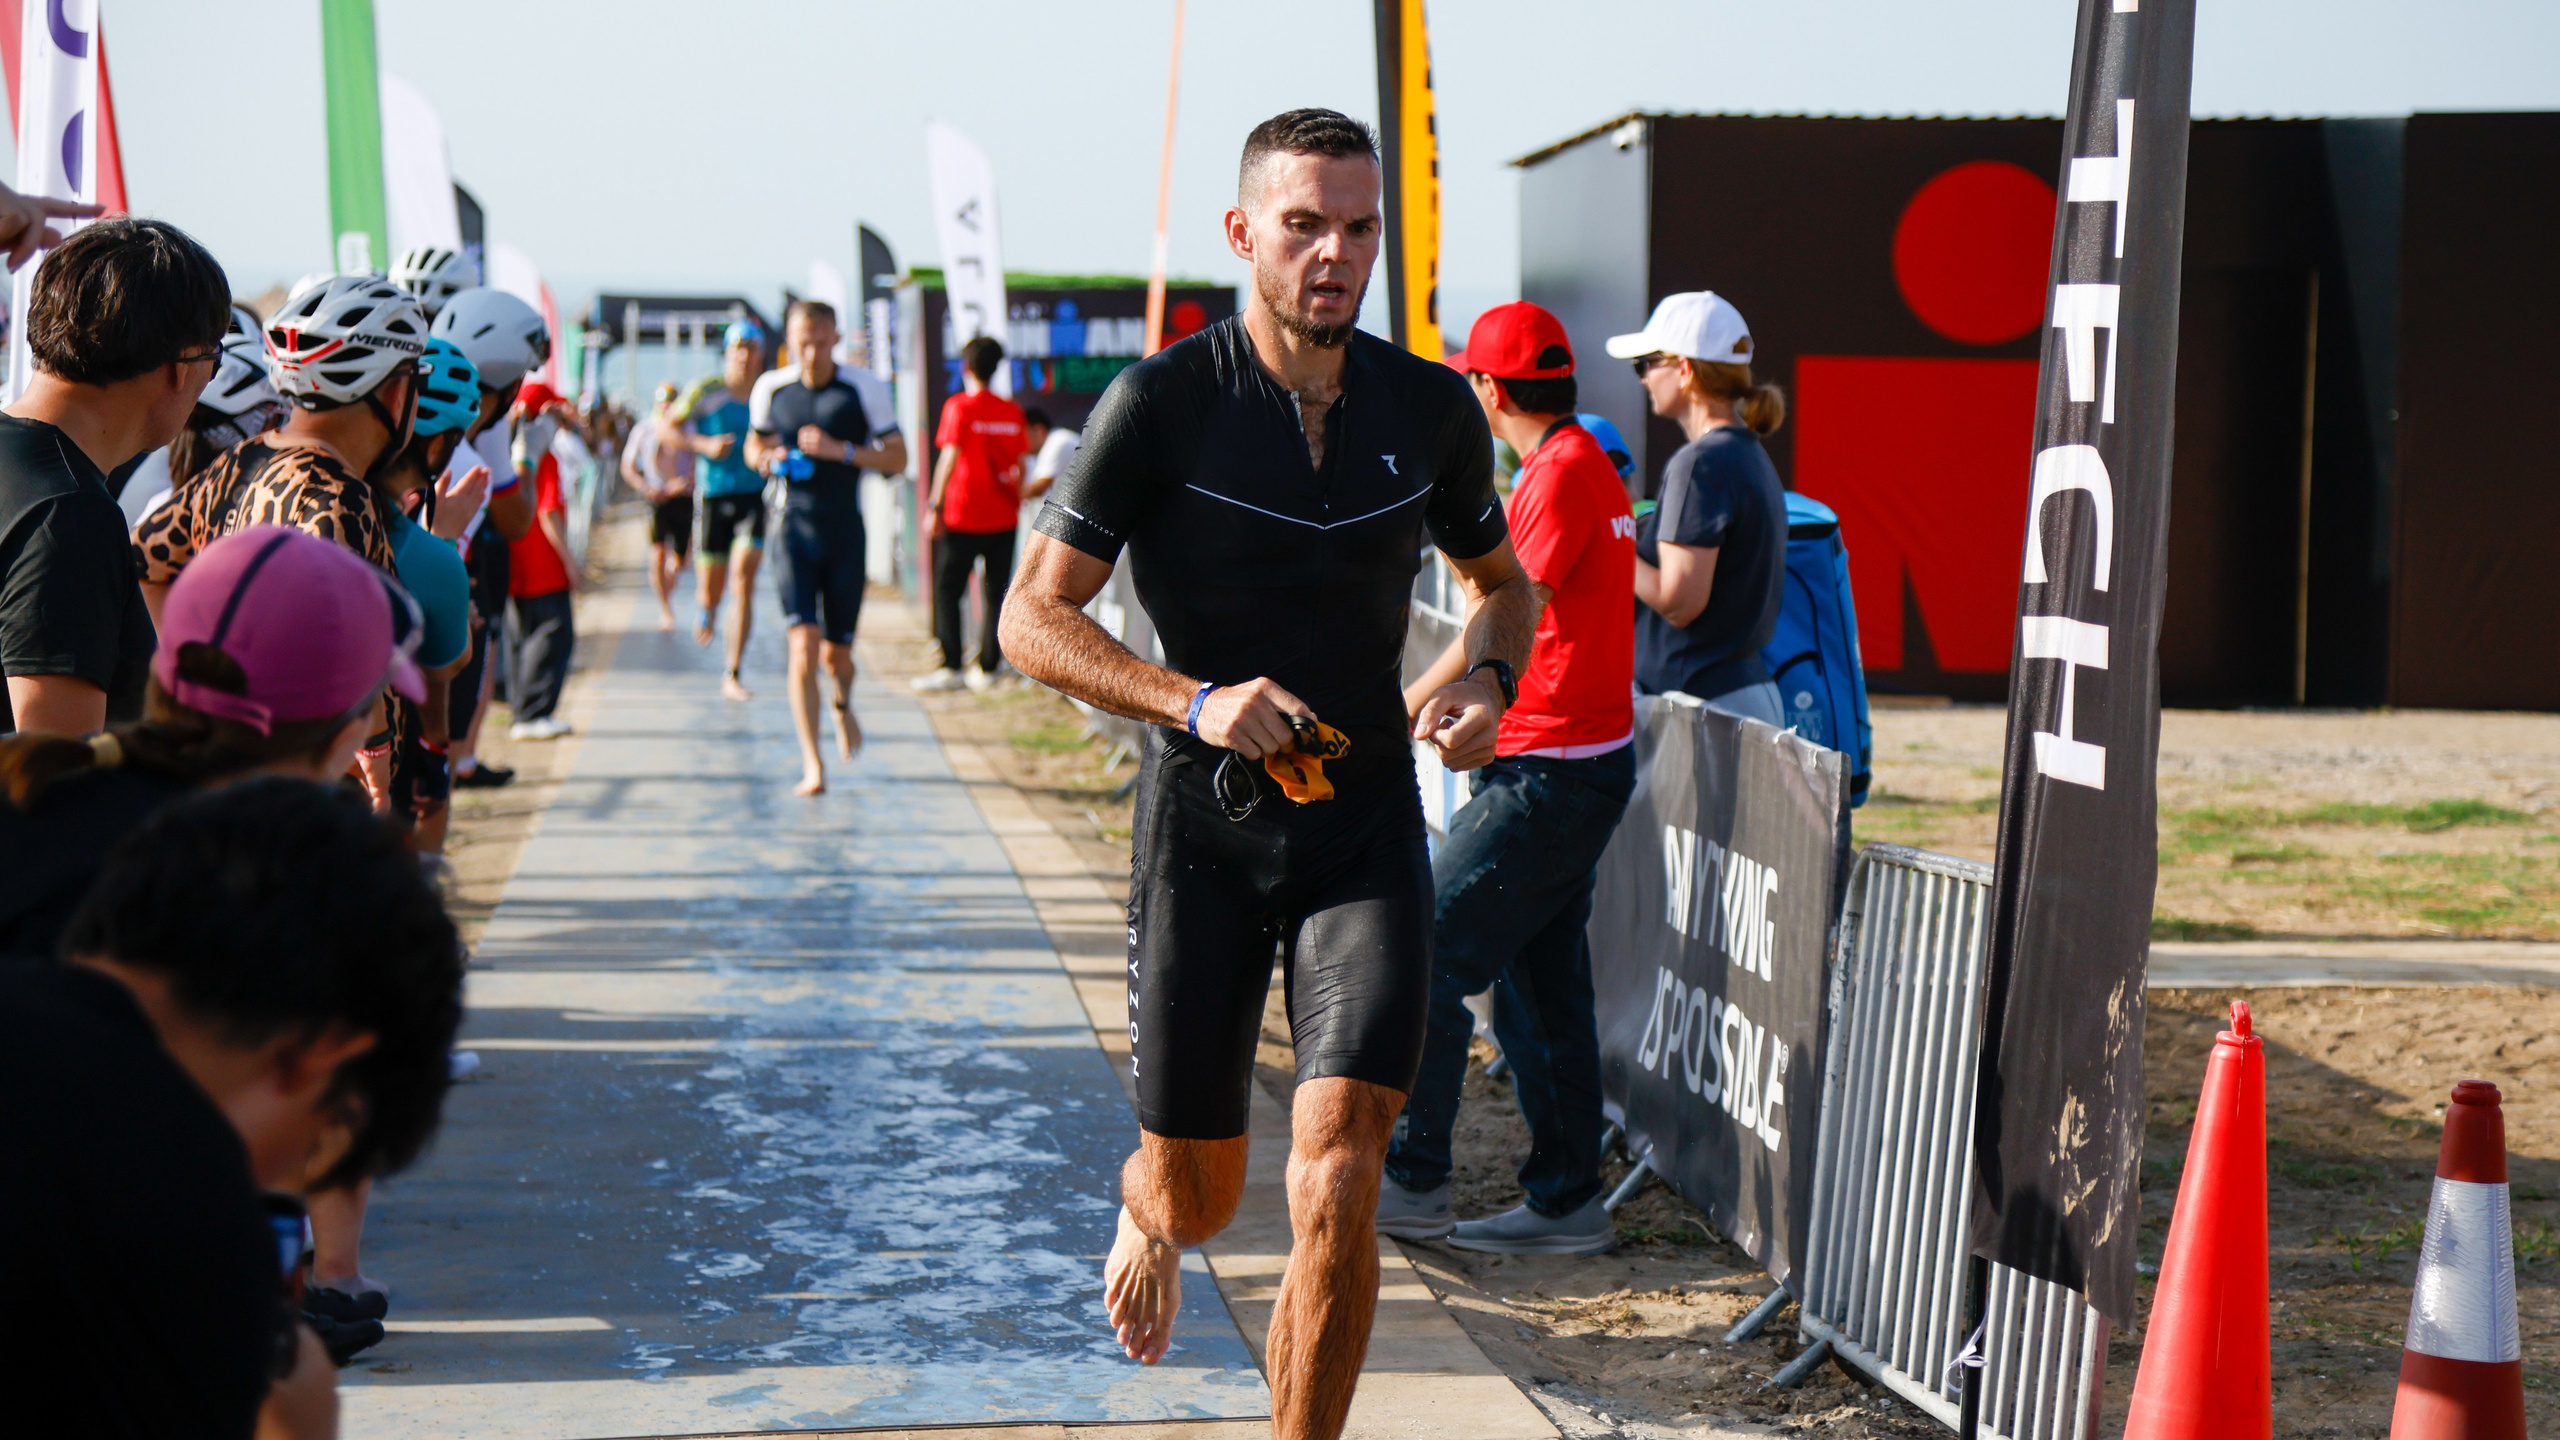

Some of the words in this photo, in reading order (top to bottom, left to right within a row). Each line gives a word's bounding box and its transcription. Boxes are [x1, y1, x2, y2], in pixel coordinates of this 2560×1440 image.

[1087, 520, 1115, 537] RYZON
[1128, 927, 1140, 1078] RYZON
[1637, 965, 1674, 1072] IS
